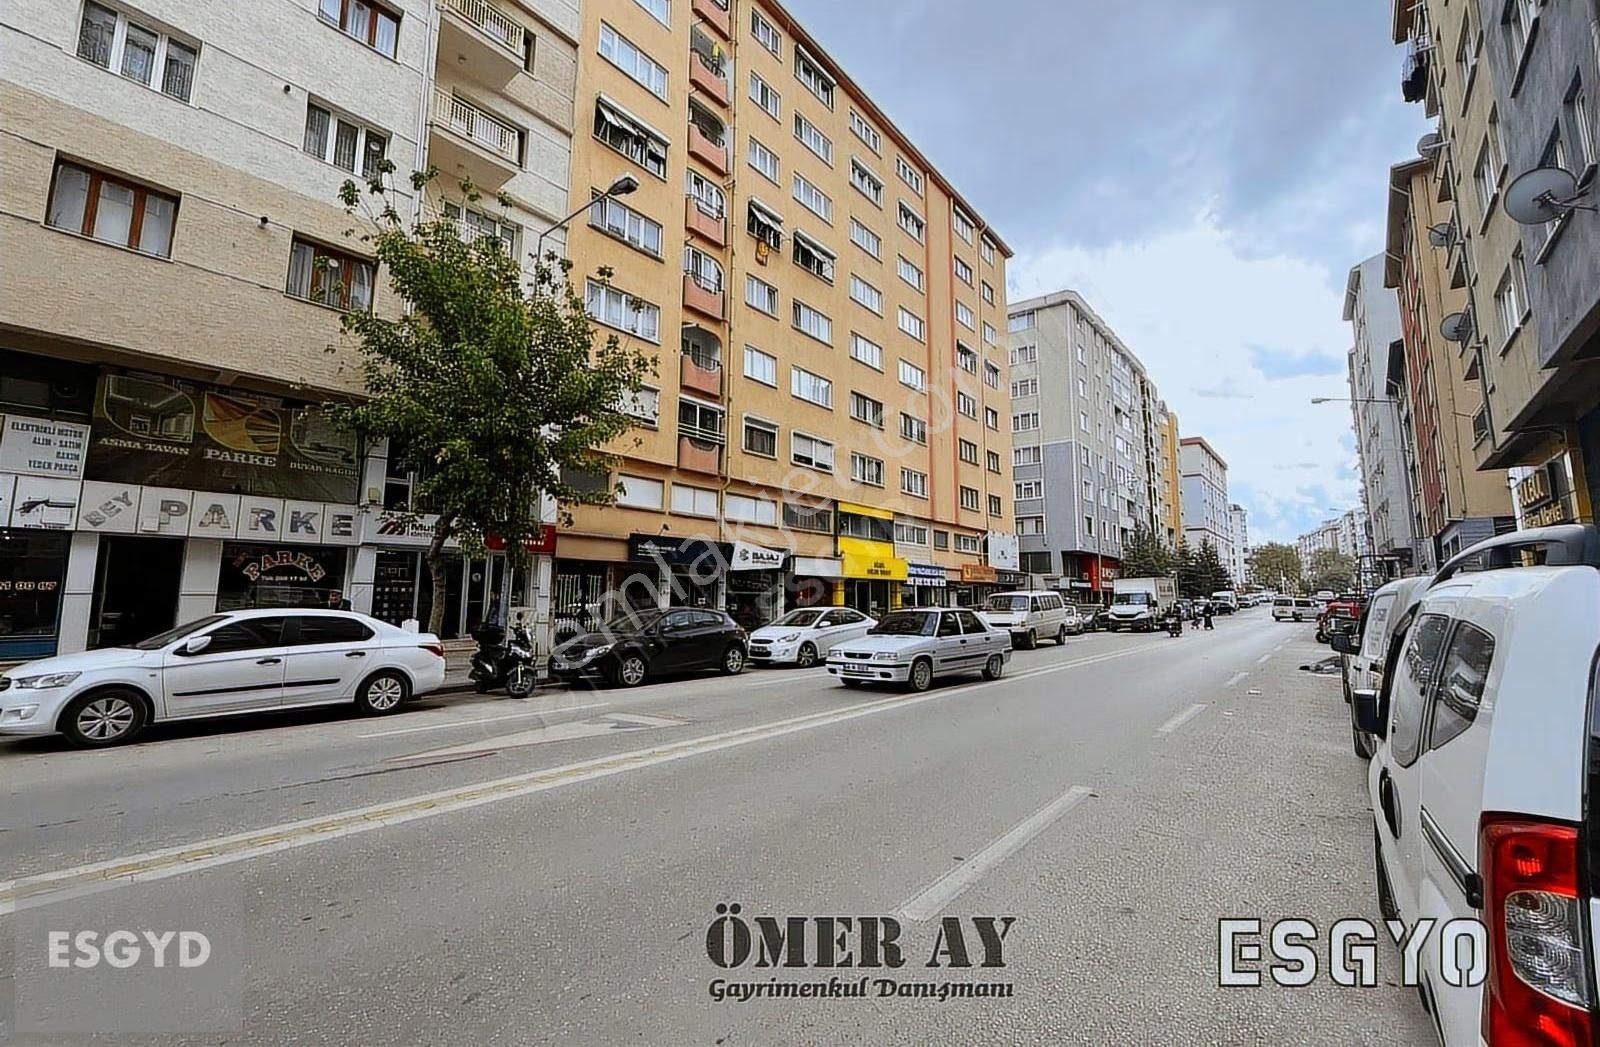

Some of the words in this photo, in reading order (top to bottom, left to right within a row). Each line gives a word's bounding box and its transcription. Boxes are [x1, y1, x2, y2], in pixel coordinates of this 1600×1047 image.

[144, 443, 190, 456] TAVAN
[204, 447, 277, 468] PARKE
[158, 498, 353, 537] PARKE
[242, 550, 326, 582] PARKE
